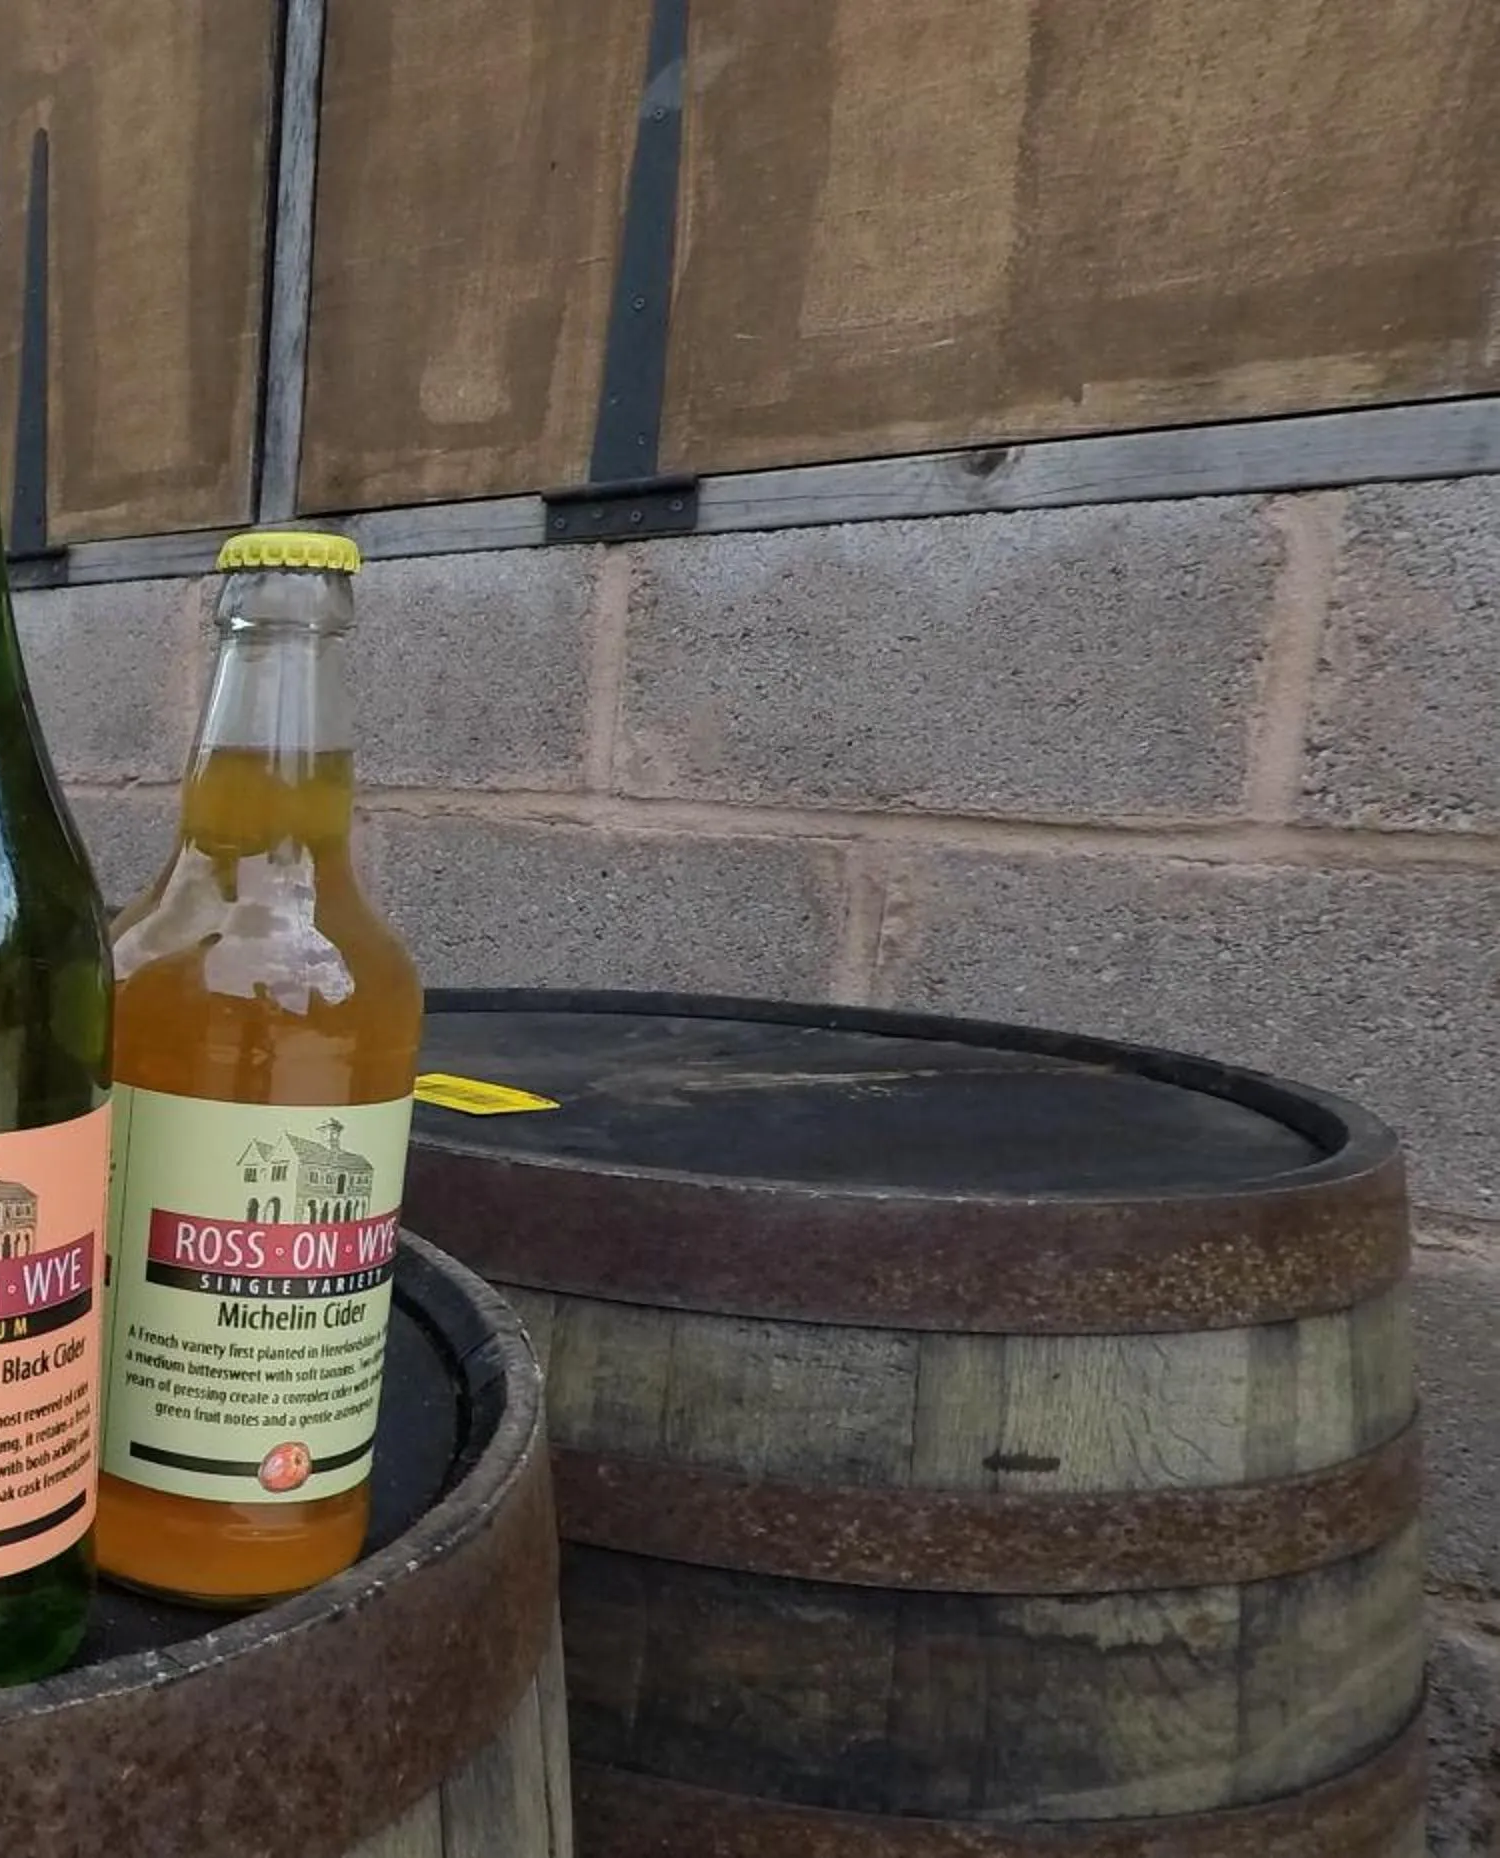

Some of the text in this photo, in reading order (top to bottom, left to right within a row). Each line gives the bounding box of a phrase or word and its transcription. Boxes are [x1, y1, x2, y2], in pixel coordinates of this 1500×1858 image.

[174, 1217, 397, 1271] ROSS ON WYE
[23, 1247, 82, 1303] WYE
[200, 1274, 292, 1297] SINGLE
[217, 1300, 367, 1331] Michelin Cider
[128, 1324, 136, 1337] A
[138, 1326, 179, 1349] French
[181, 1340, 226, 1360] variety
[229, 1343, 254, 1359] first
[257, 1345, 306, 1362] planted
[307, 1345, 319, 1358] in
[1, 1352, 50, 1384] Black
[53, 1337, 86, 1370] Cider
[135, 1351, 185, 1373] medium
[187, 1360, 261, 1382] bittersweet
[265, 1368, 293, 1381] with
[296, 1367, 317, 1382] soft
[125, 1371, 155, 1388] years
[158, 1380, 171, 1392] of
[174, 1383, 226, 1406] pressing
[229, 1392, 269, 1404] create
[272, 1393, 279, 1404] a
[24, 1394, 62, 1422] revered
[155, 1402, 191, 1419] green
[194, 1406, 221, 1424] fruit
[224, 1414, 259, 1426] notes
[262, 1412, 287, 1426] and
[289, 1416, 296, 1426] a
[25, 1433, 33, 1446] it
[26, 1450, 51, 1471] both
[17, 1477, 41, 1498] cask
